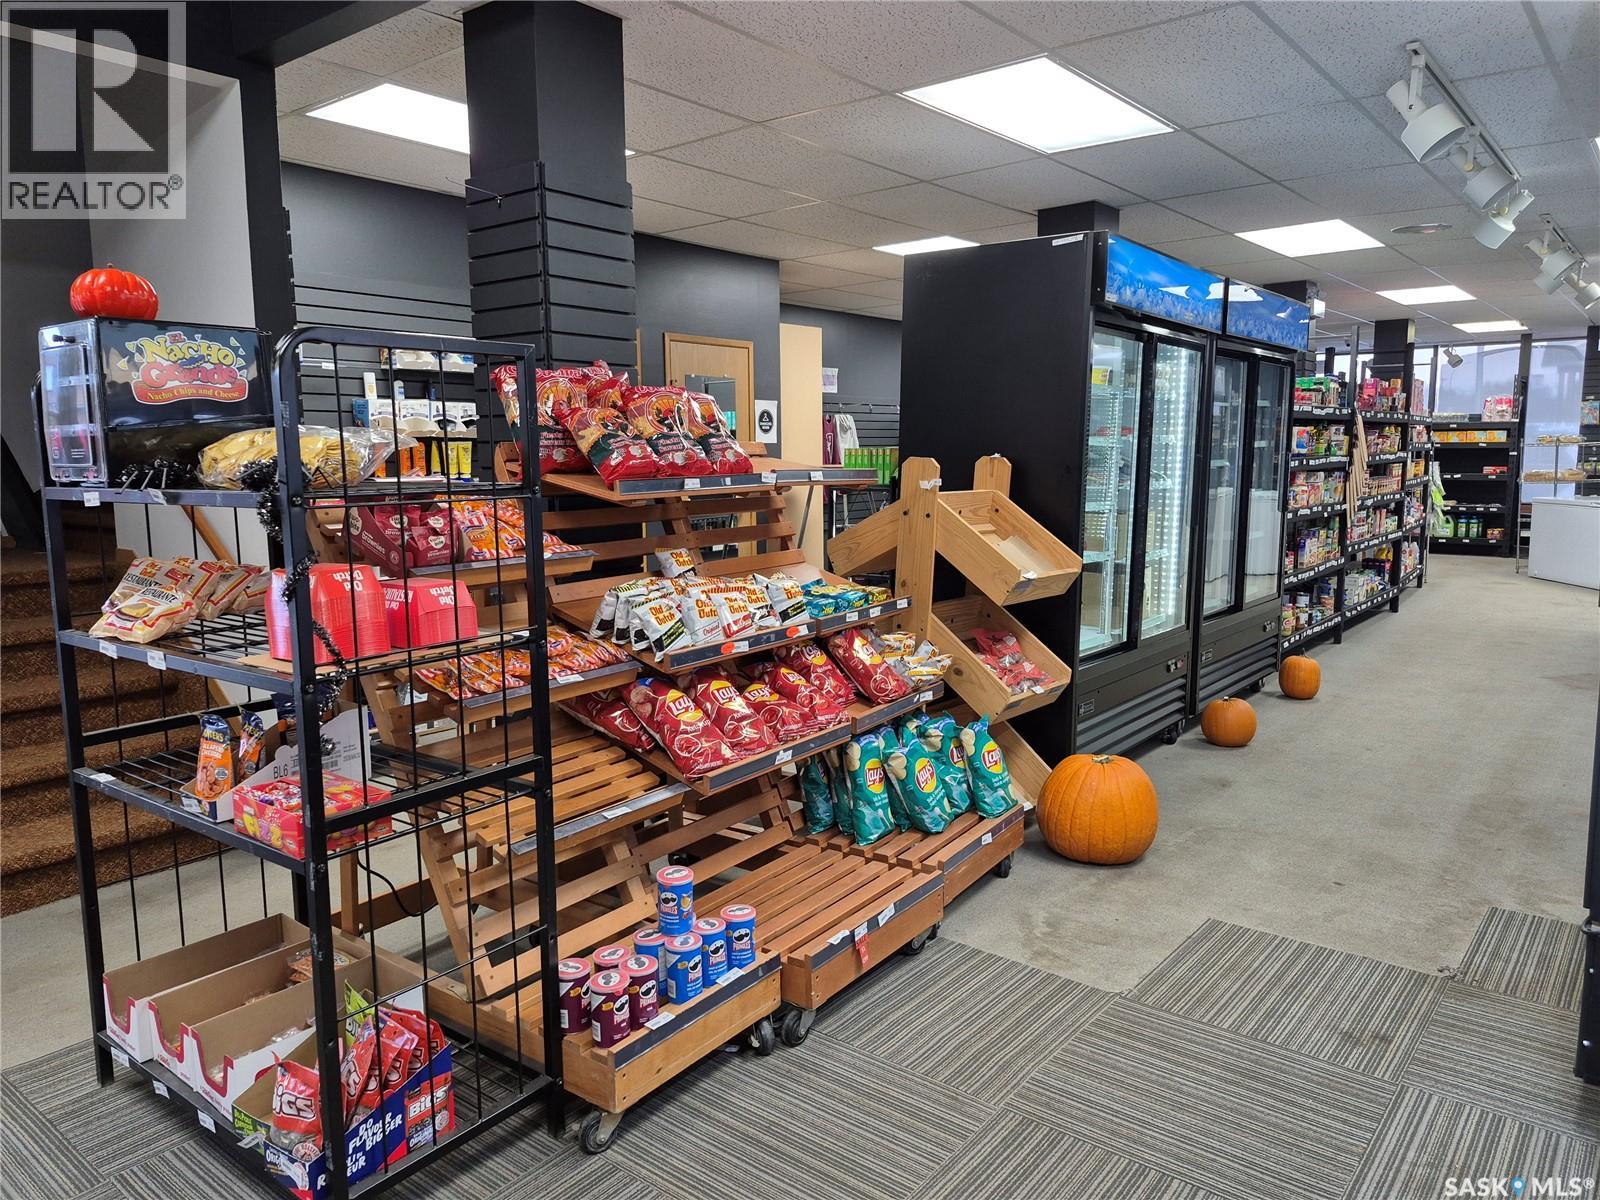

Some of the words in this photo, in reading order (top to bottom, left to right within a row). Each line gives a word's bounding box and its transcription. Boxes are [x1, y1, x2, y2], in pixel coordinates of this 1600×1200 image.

[174, 388, 197, 398] Chips
[198, 387, 213, 396] and
[214, 389, 240, 399] Cheese
[649, 604, 664, 617] Old
[655, 611, 677, 626] Dutch
[702, 622, 720, 636] Original
[273, 764, 289, 780] BL6
